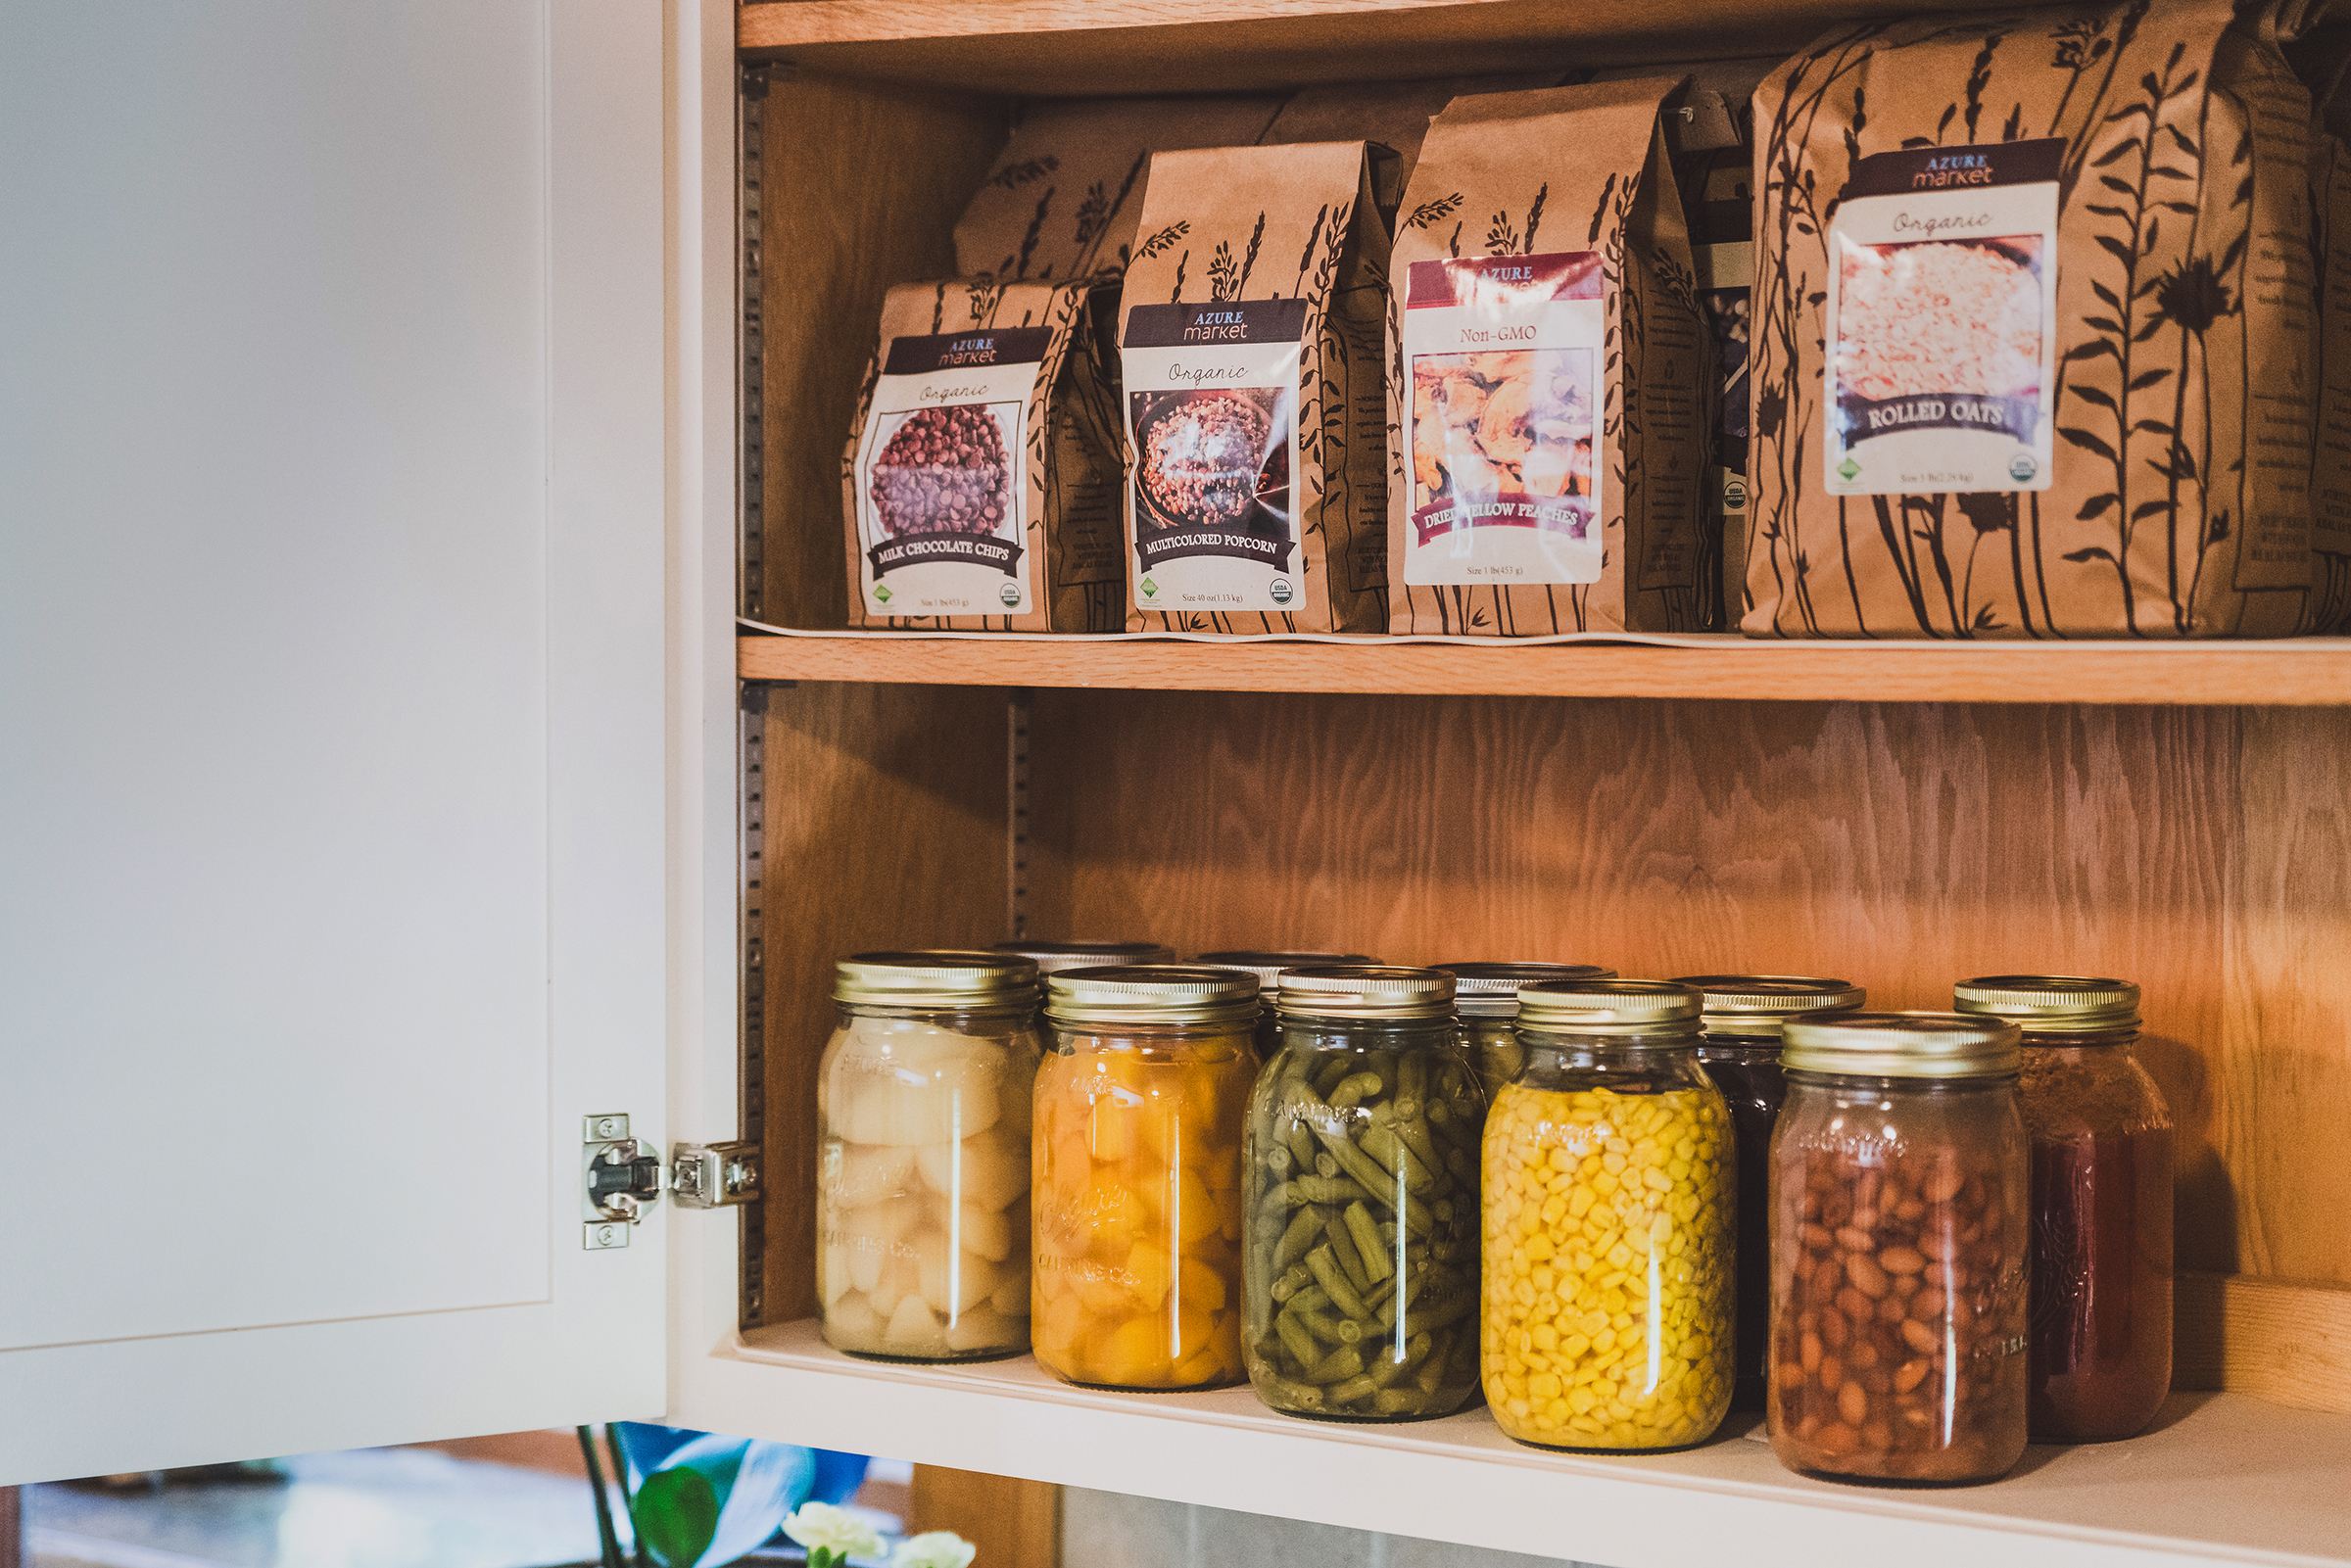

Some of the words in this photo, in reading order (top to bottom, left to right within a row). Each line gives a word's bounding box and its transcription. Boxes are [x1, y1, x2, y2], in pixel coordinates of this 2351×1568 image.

[1926, 155, 1988, 170] AZURE
[1912, 166, 1993, 188] market
[1893, 213, 1992, 237] Organic
[1480, 266, 1533, 281] AZURE
[1194, 311, 1244, 325] AZURE
[1183, 323, 1248, 341] market
[1461, 325, 1537, 343] Non-GMO
[948, 338, 994, 352] AZURE
[937, 350, 997, 366] market
[1169, 363, 1249, 386] Organic
[919, 384, 990, 404] Organic
[1868, 400, 1946, 429] ROLLED
[1950, 400, 2005, 424] OATS
[1463, 502, 1515, 518] ELLOW
[1517, 503, 1579, 526] PEACHES
[878, 546, 905, 564] MILK
[906, 540, 974, 555] CHOCOLATE
[975, 543, 1010, 561] CHIPS
[1146, 534, 1223, 554] MULTICOLORED
[1224, 535, 1277, 554] POPCORN
[1467, 566, 1482, 575] Size
